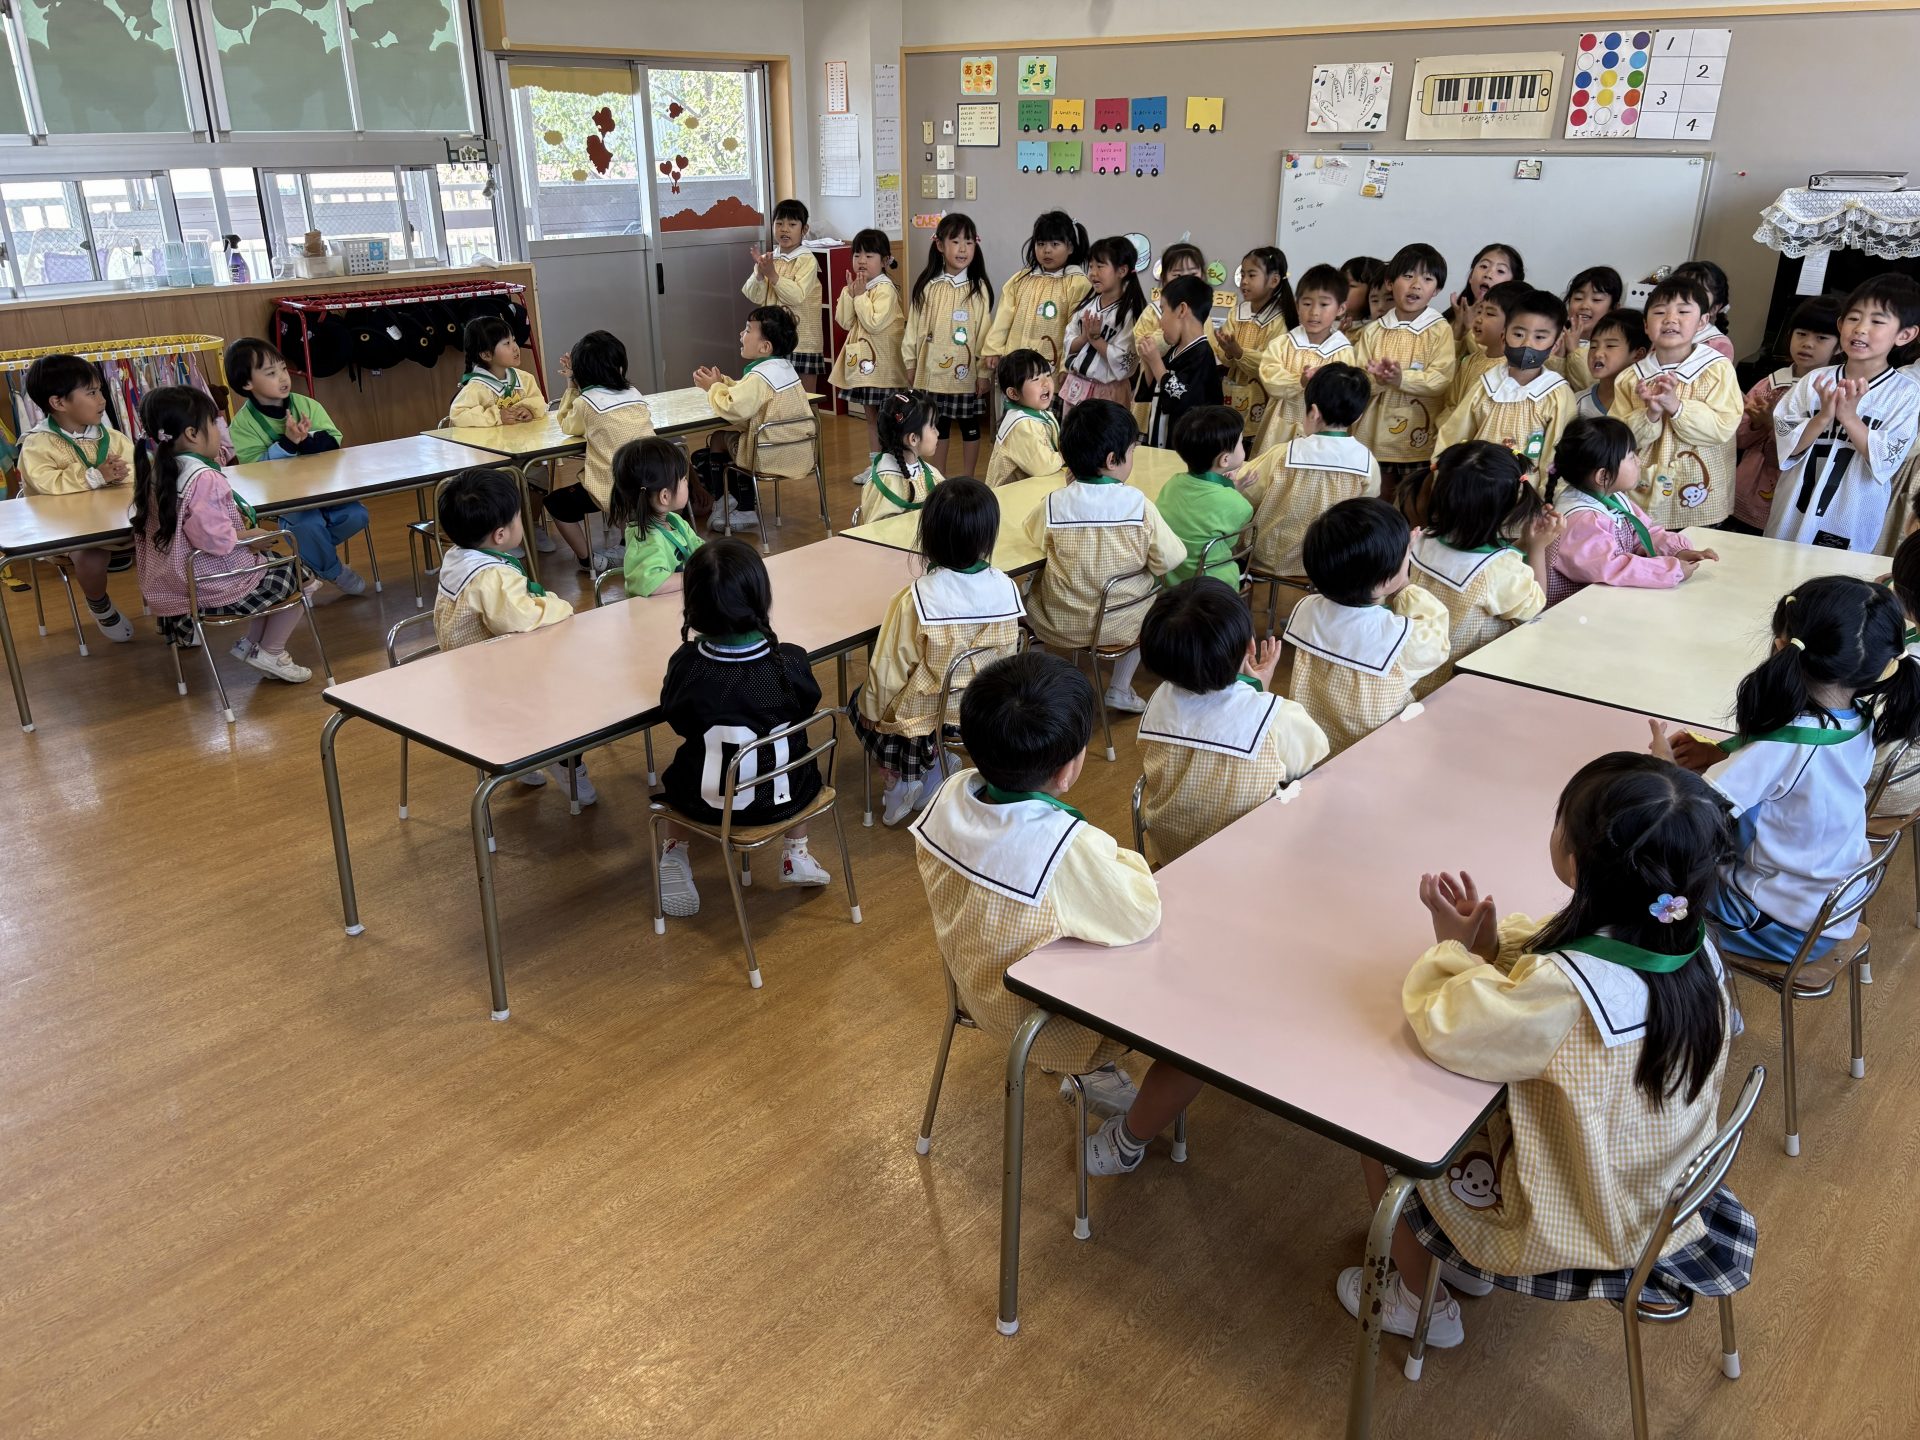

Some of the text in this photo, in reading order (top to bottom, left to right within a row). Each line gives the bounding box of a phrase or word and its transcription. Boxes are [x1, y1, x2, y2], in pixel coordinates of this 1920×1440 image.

[1666, 36, 1675, 50] 1
[964, 63, 992, 76] あるき
[1696, 64, 1709, 79] 2
[1022, 79, 1051, 90] こーす
[1656, 90, 1668, 106] 3
[1685, 118, 1699, 132] 4
[1215, 293, 1235, 305] うび
